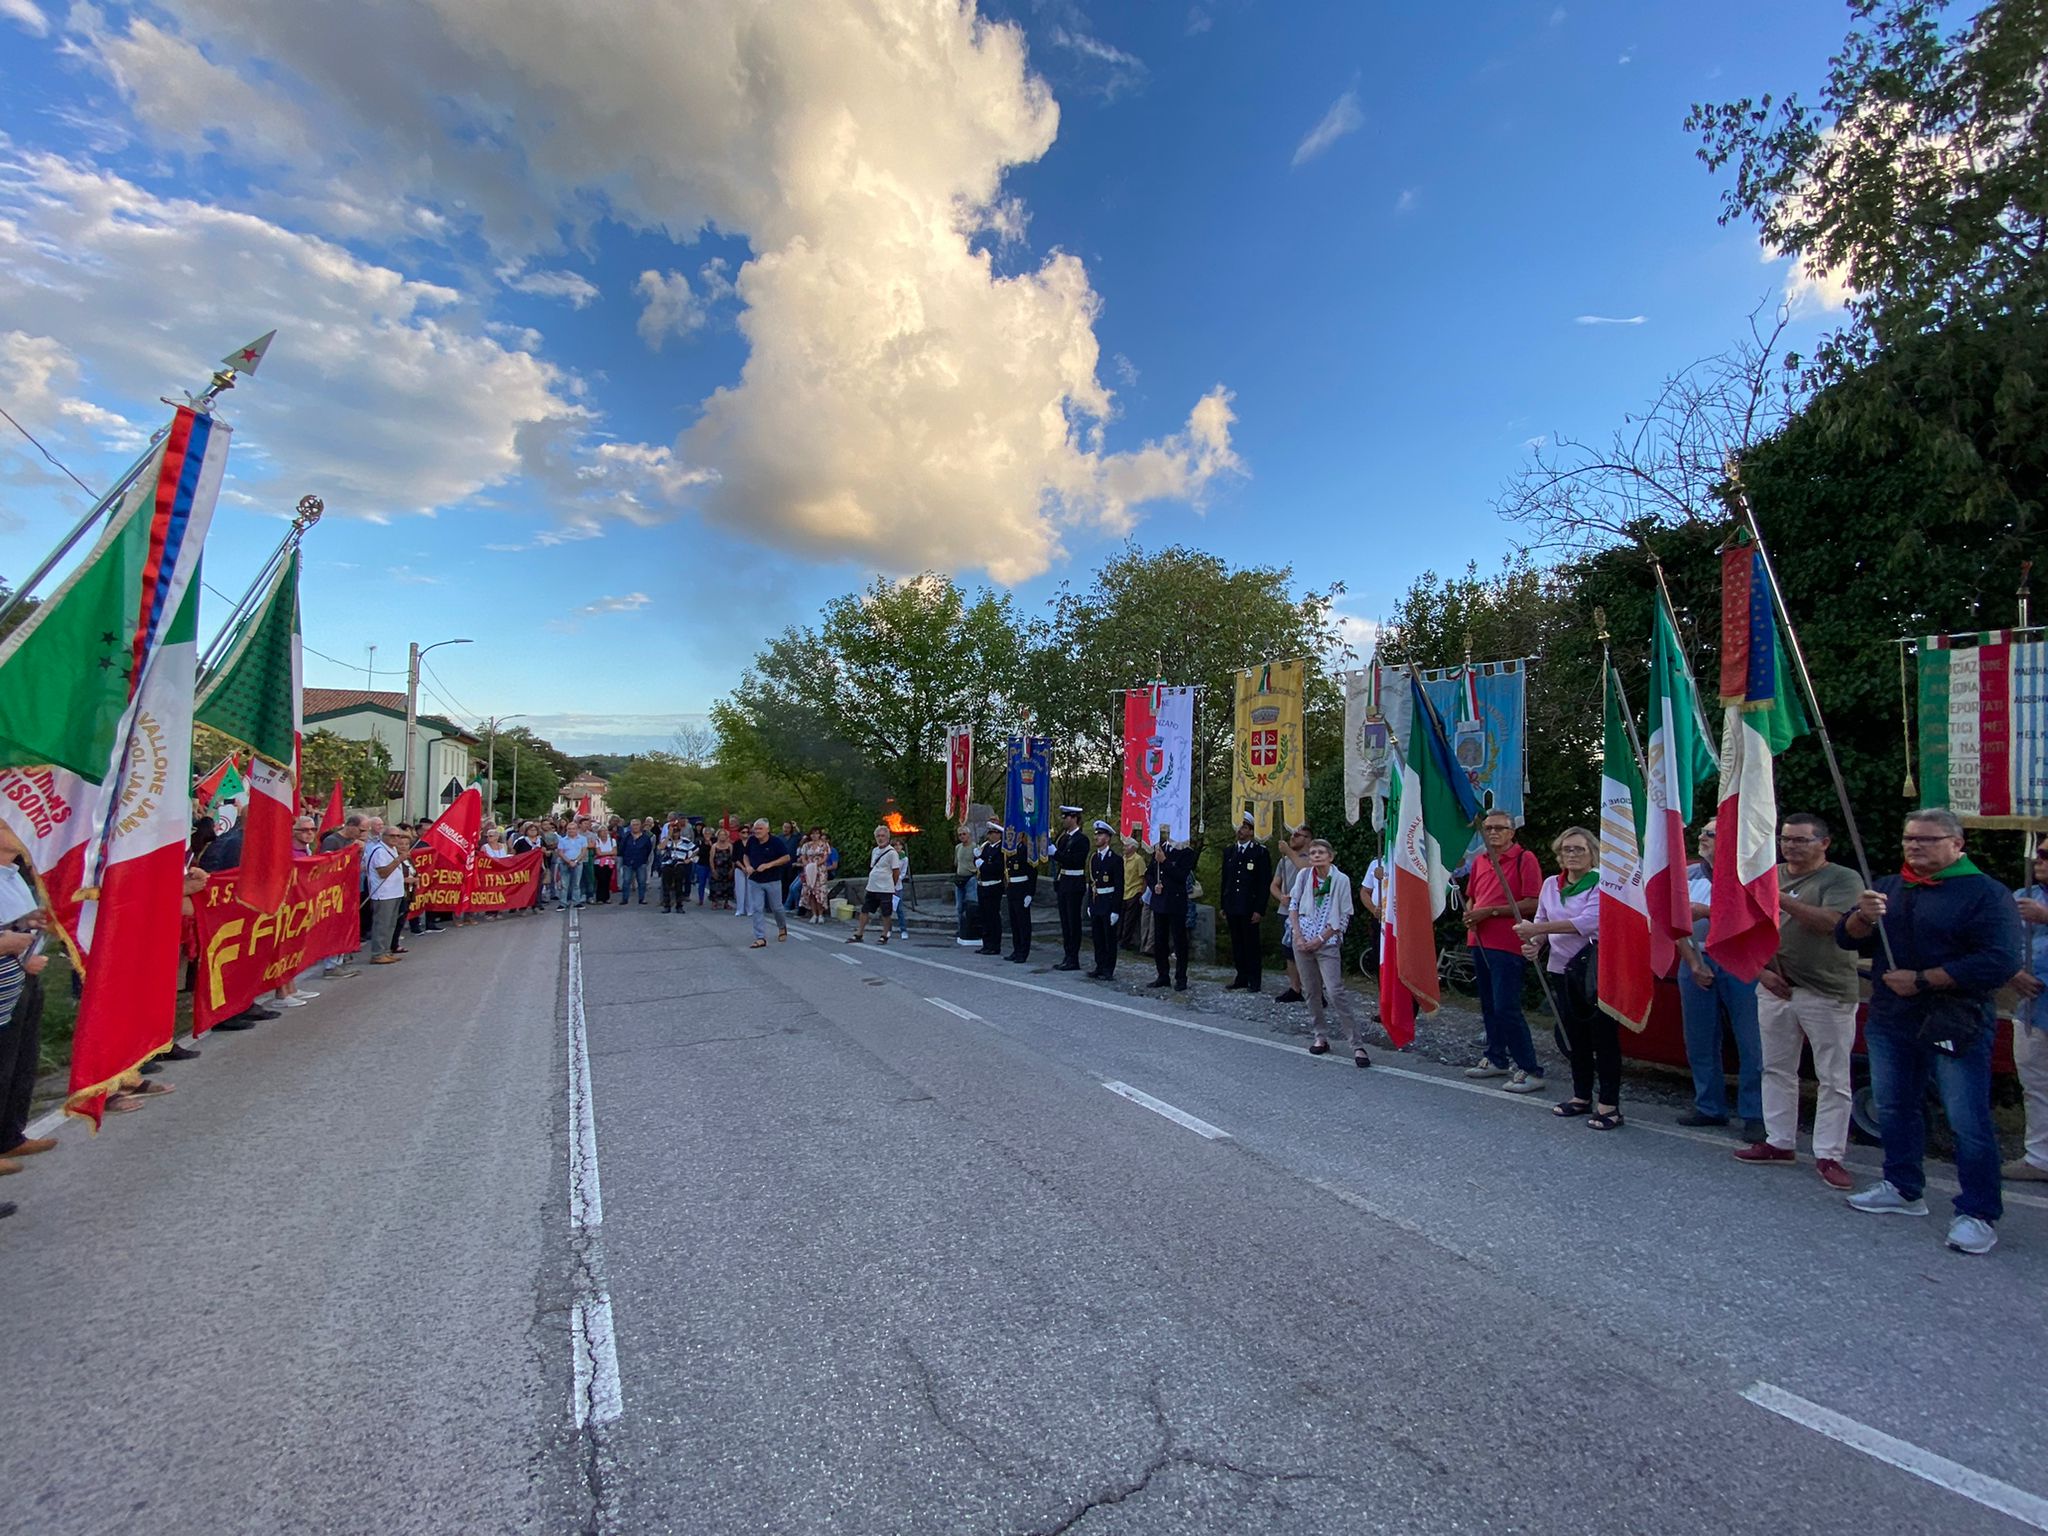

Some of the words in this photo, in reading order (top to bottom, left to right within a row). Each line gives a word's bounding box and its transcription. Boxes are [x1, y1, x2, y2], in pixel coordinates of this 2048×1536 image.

[131, 736, 146, 767] DOL
[138, 711, 168, 795] VALLONE
[1406, 815, 1422, 855] NAZIONALE
[485, 870, 530, 886] ITALIANI
[470, 891, 506, 905] GORIZIA
